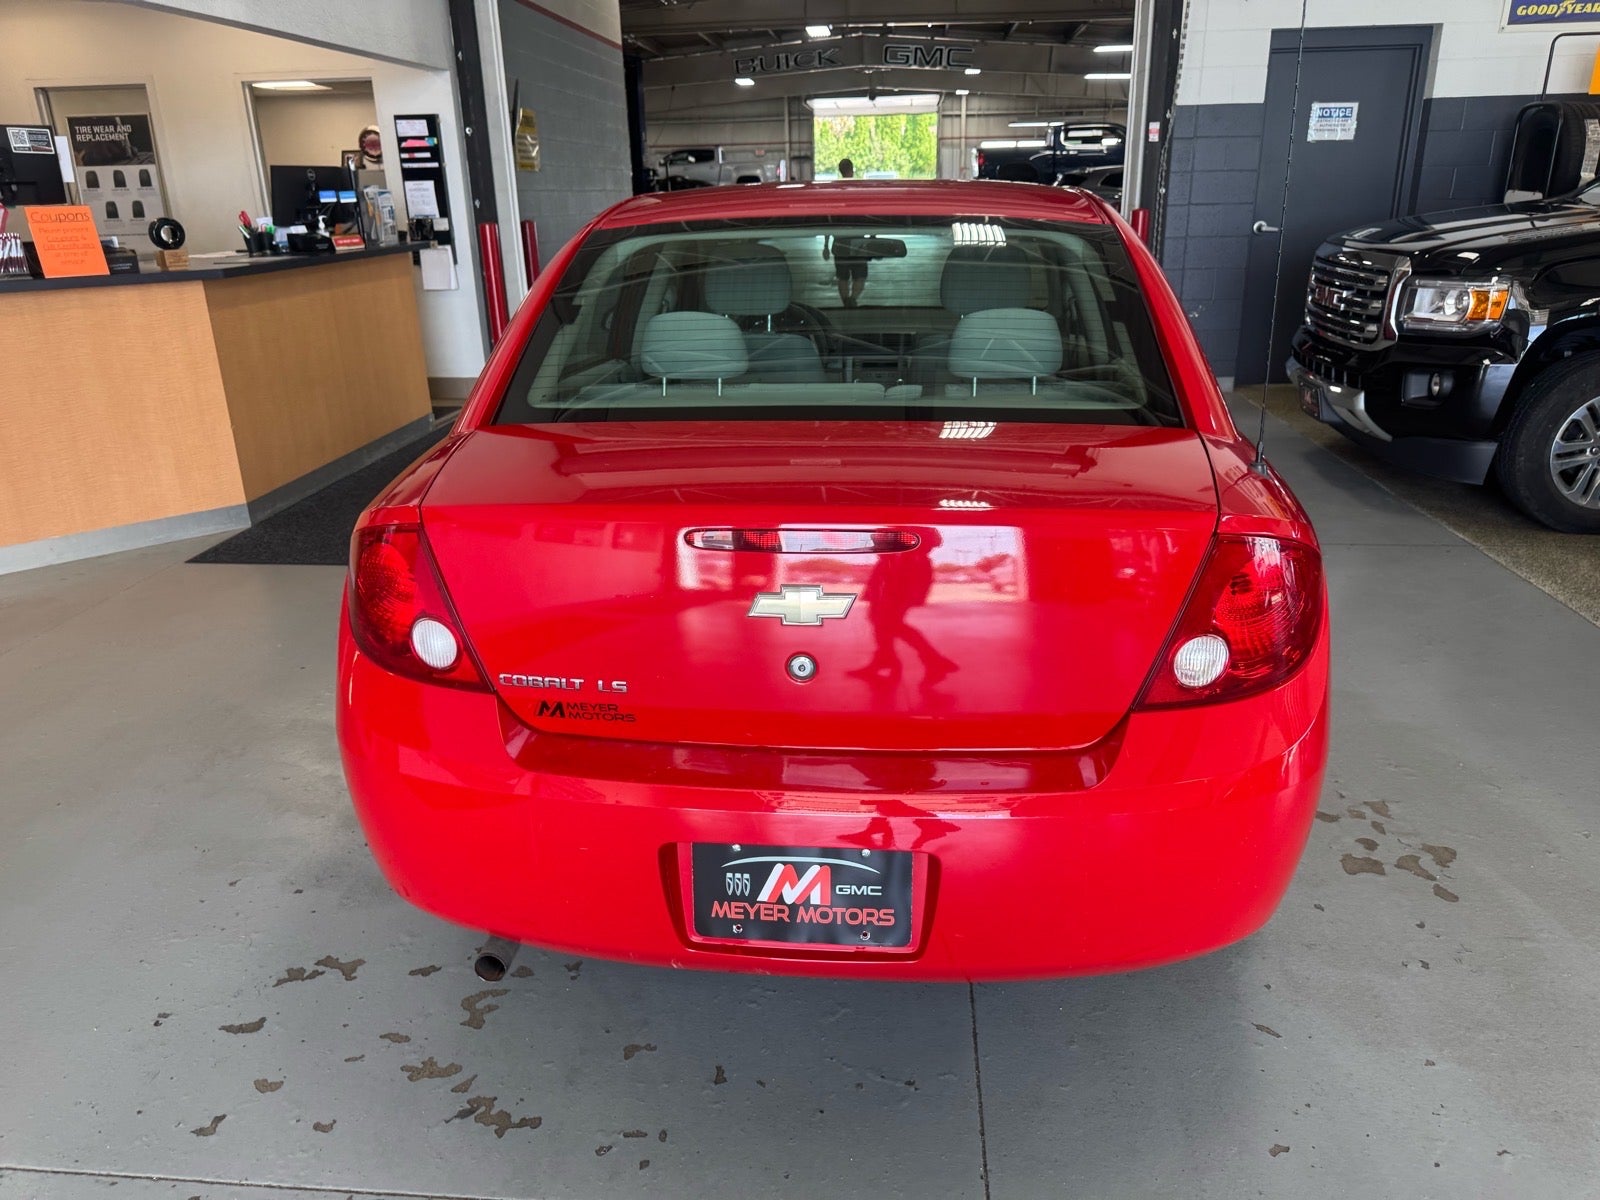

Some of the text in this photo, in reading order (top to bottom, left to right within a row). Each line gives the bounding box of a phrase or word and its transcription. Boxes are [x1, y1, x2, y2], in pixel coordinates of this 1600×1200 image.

[1516, 2, 1600, 17] GOODYEAR
[734, 48, 842, 75] BUICK
[883, 44, 975, 68] GMC
[1316, 108, 1353, 117] NOTICE
[74, 124, 132, 135] TIRE WEAR AND
[76, 133, 129, 142] REPLACEMENT
[30, 211, 90, 223] Coupons
[499, 673, 628, 693] COBALT LS
[566, 702, 619, 712] MEYER
[568, 711, 636, 722] MOTORS
[835, 884, 882, 896] GMC
[711, 900, 896, 926] MEYER MOTORS
